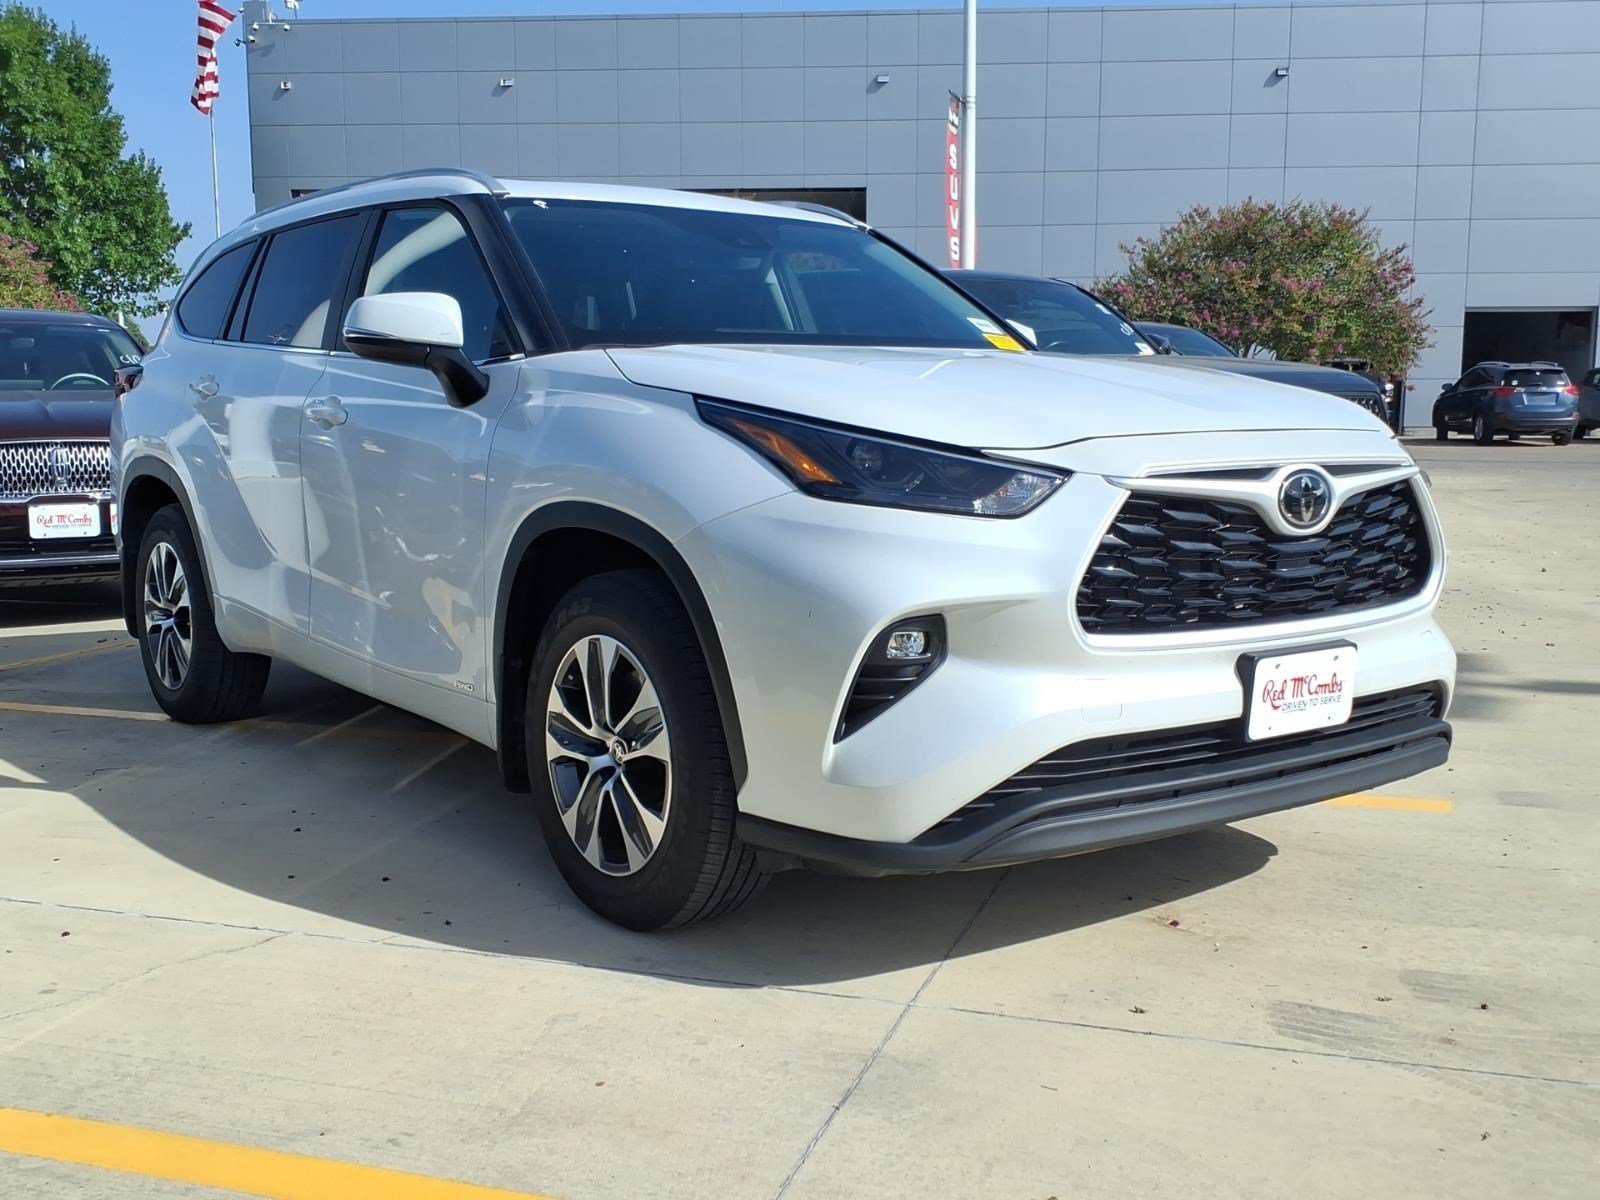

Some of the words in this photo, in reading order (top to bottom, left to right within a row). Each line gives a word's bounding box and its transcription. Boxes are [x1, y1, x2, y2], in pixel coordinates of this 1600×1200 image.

[36, 514, 53, 528] Red
[1262, 679, 1287, 710] Red
[1290, 672, 1343, 699] McCombs
[1281, 700, 1307, 712] DRIVEN
[1309, 697, 1318, 707] TO
[1319, 694, 1342, 705] SERVE
